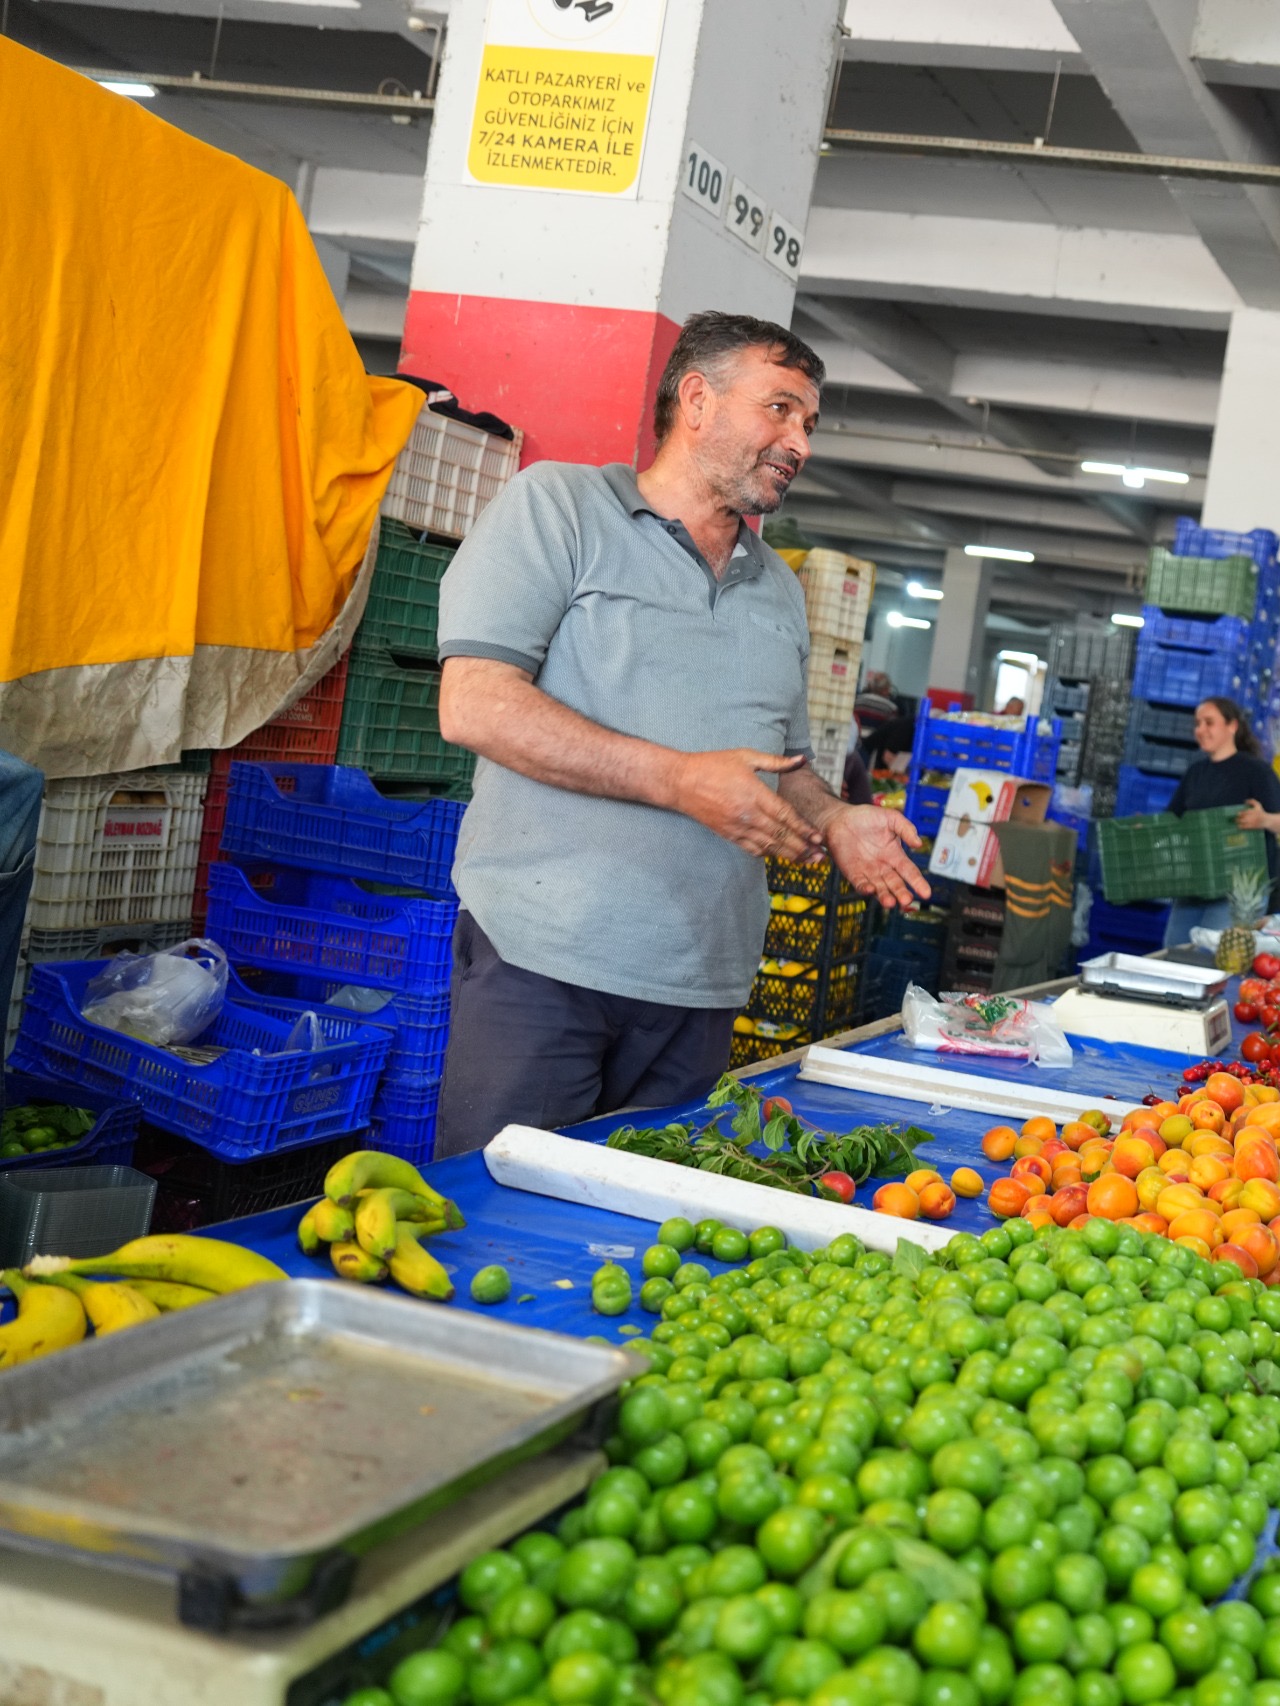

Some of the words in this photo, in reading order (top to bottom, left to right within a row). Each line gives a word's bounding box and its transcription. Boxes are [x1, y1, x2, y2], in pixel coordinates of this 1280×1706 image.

[485, 68, 530, 85] KATLI
[535, 71, 622, 91] PAZARYERİ
[627, 81, 646, 93] ve
[508, 91, 616, 112] OTOPARKIMIZ
[484, 107, 596, 132] GÜVENLİĞİNİZ
[601, 115, 634, 135] İÇİN
[478, 130, 517, 147] 7/24
[522, 134, 600, 153] KAMERA
[606, 138, 635, 156] İLE
[487, 149, 617, 177] İZLENMEKTEDİR.
[689, 152, 722, 204] 100
[735, 194, 764, 237] 99
[774, 226, 800, 268] 98
